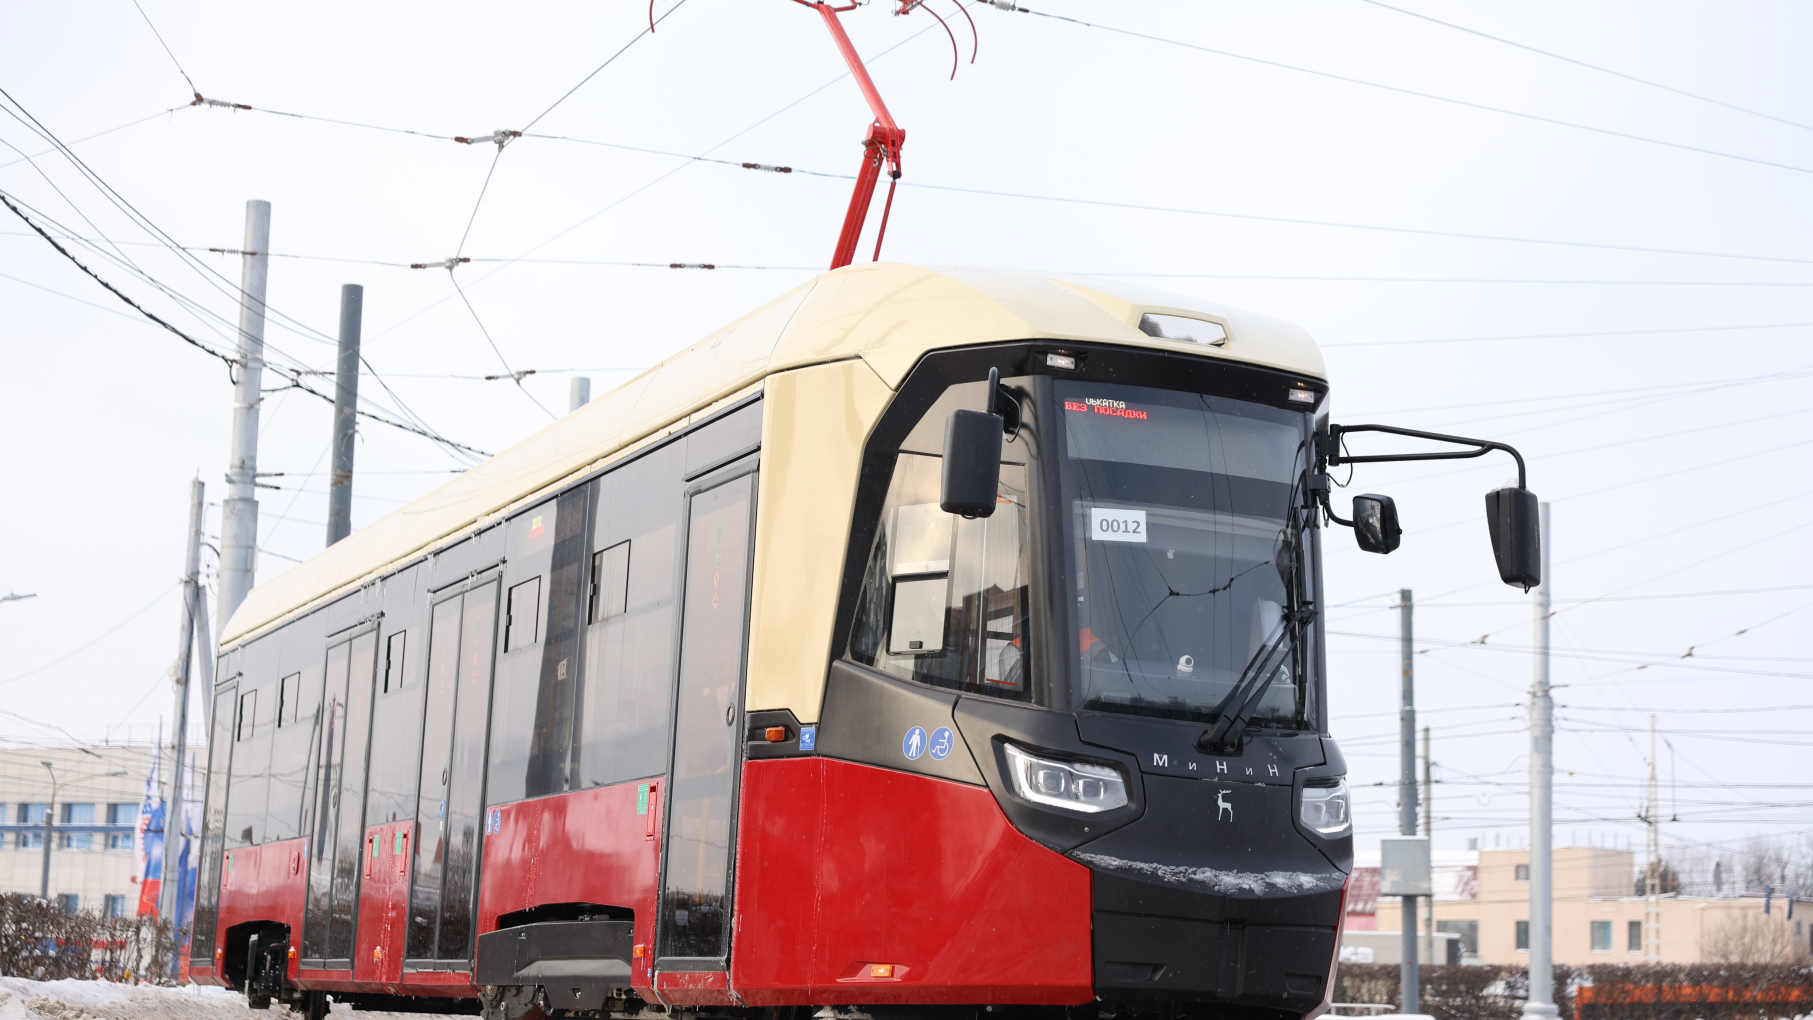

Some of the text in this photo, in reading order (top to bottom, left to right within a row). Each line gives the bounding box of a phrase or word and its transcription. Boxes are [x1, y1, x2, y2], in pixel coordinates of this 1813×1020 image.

[1064, 401, 1148, 420] БЕЗ ПОСАДКИ
[1099, 518, 1142, 534] 0012
